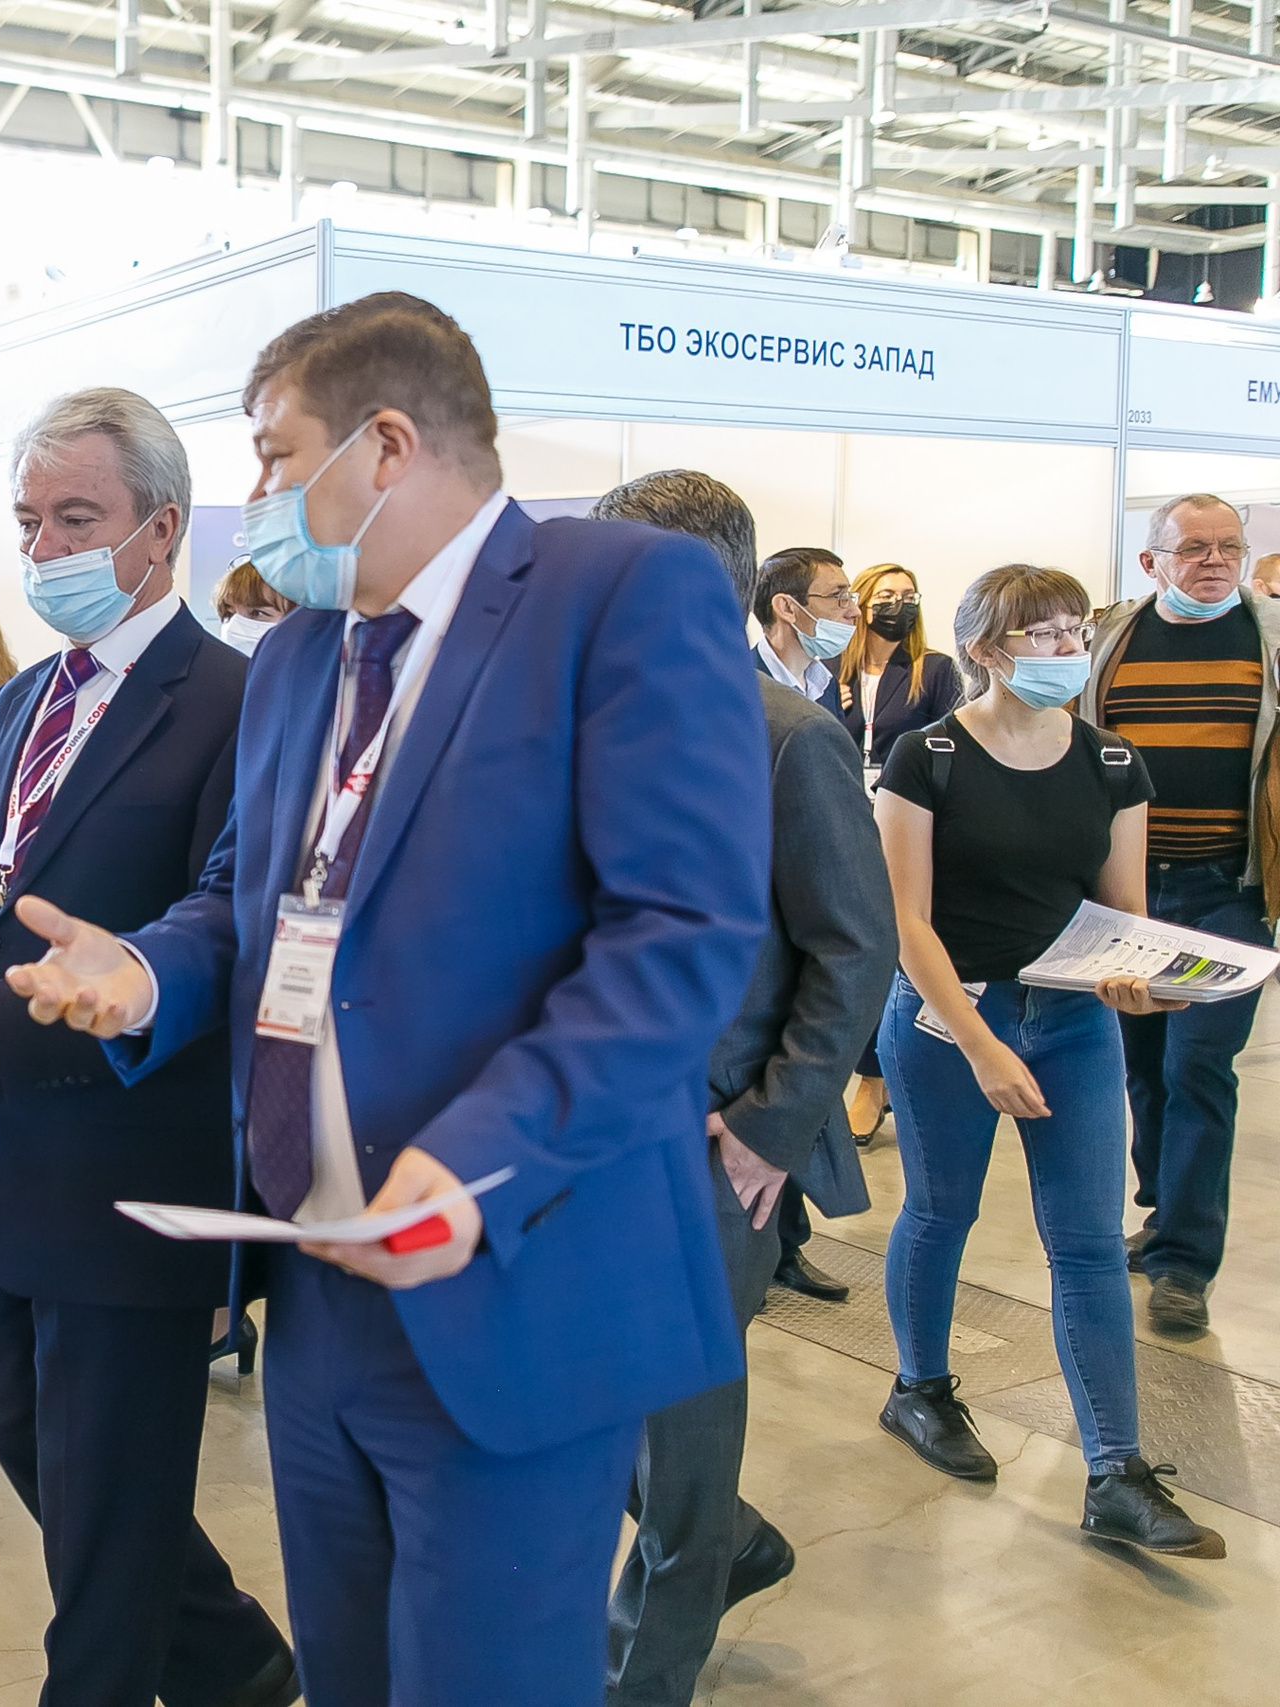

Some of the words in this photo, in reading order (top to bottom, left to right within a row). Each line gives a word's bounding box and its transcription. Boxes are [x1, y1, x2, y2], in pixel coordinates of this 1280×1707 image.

[619, 322, 677, 355] ТБО
[685, 328, 845, 368] ЭКОСЕРВИС
[852, 343, 935, 381] ЗАПАД
[1127, 409, 1152, 424] 2033
